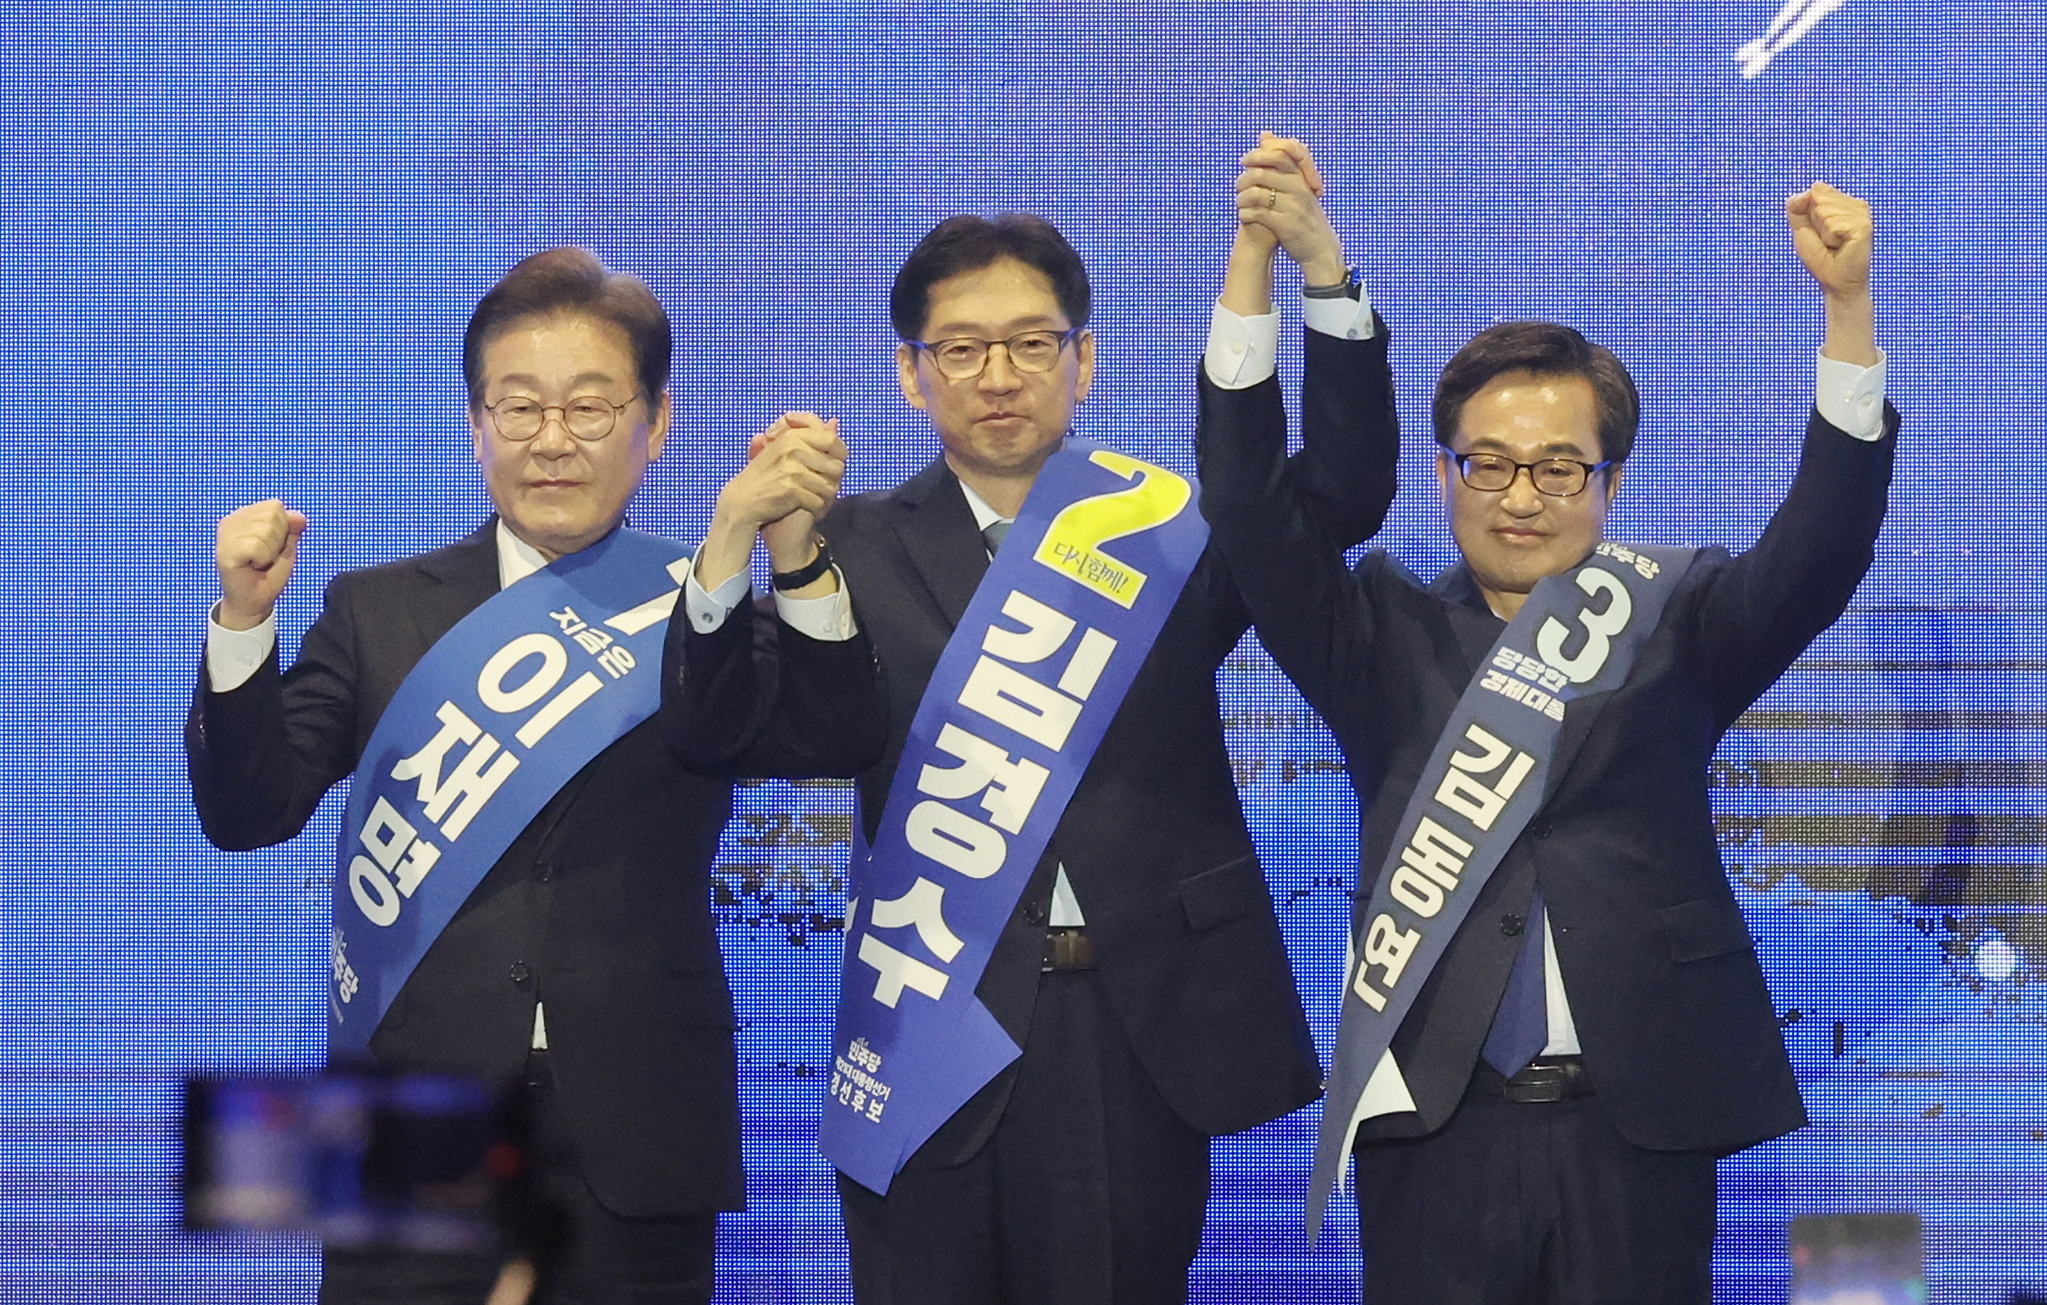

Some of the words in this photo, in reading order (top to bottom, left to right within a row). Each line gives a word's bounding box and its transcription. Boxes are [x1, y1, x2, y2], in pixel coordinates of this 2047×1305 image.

[1032, 449, 1193, 611] 2
[548, 605, 638, 681] 지금은
[1492, 646, 1568, 694] 당당한
[1536, 566, 1633, 684] 3
[348, 632, 605, 928] 이재명
[857, 588, 1119, 1011] 김경수
[1352, 723, 1536, 1014] 김동연
[847, 1040, 882, 1073] 민주당
